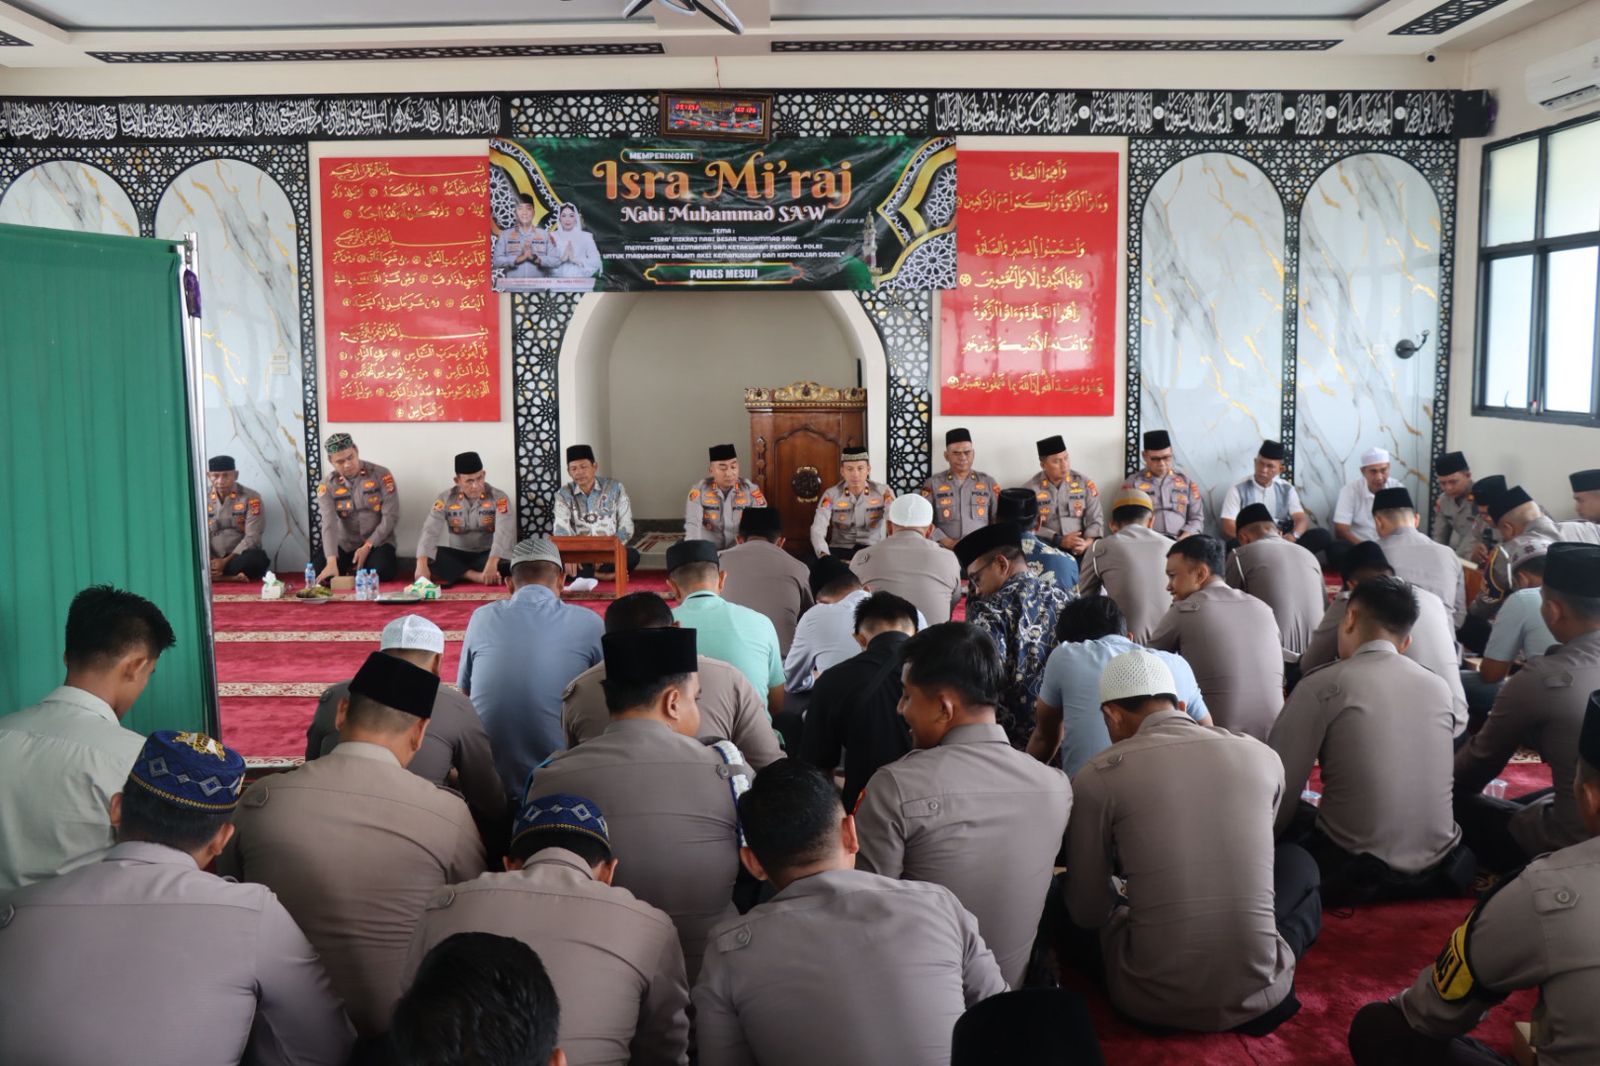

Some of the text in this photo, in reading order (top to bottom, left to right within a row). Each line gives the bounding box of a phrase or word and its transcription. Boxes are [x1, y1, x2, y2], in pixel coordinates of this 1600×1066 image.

[628, 152, 694, 161] MEMPERINGATI
[592, 160, 693, 200] Isra
[620, 203, 826, 222] Nabi Muhammad SAW
[690, 268, 758, 279] POLRES MESUJI
